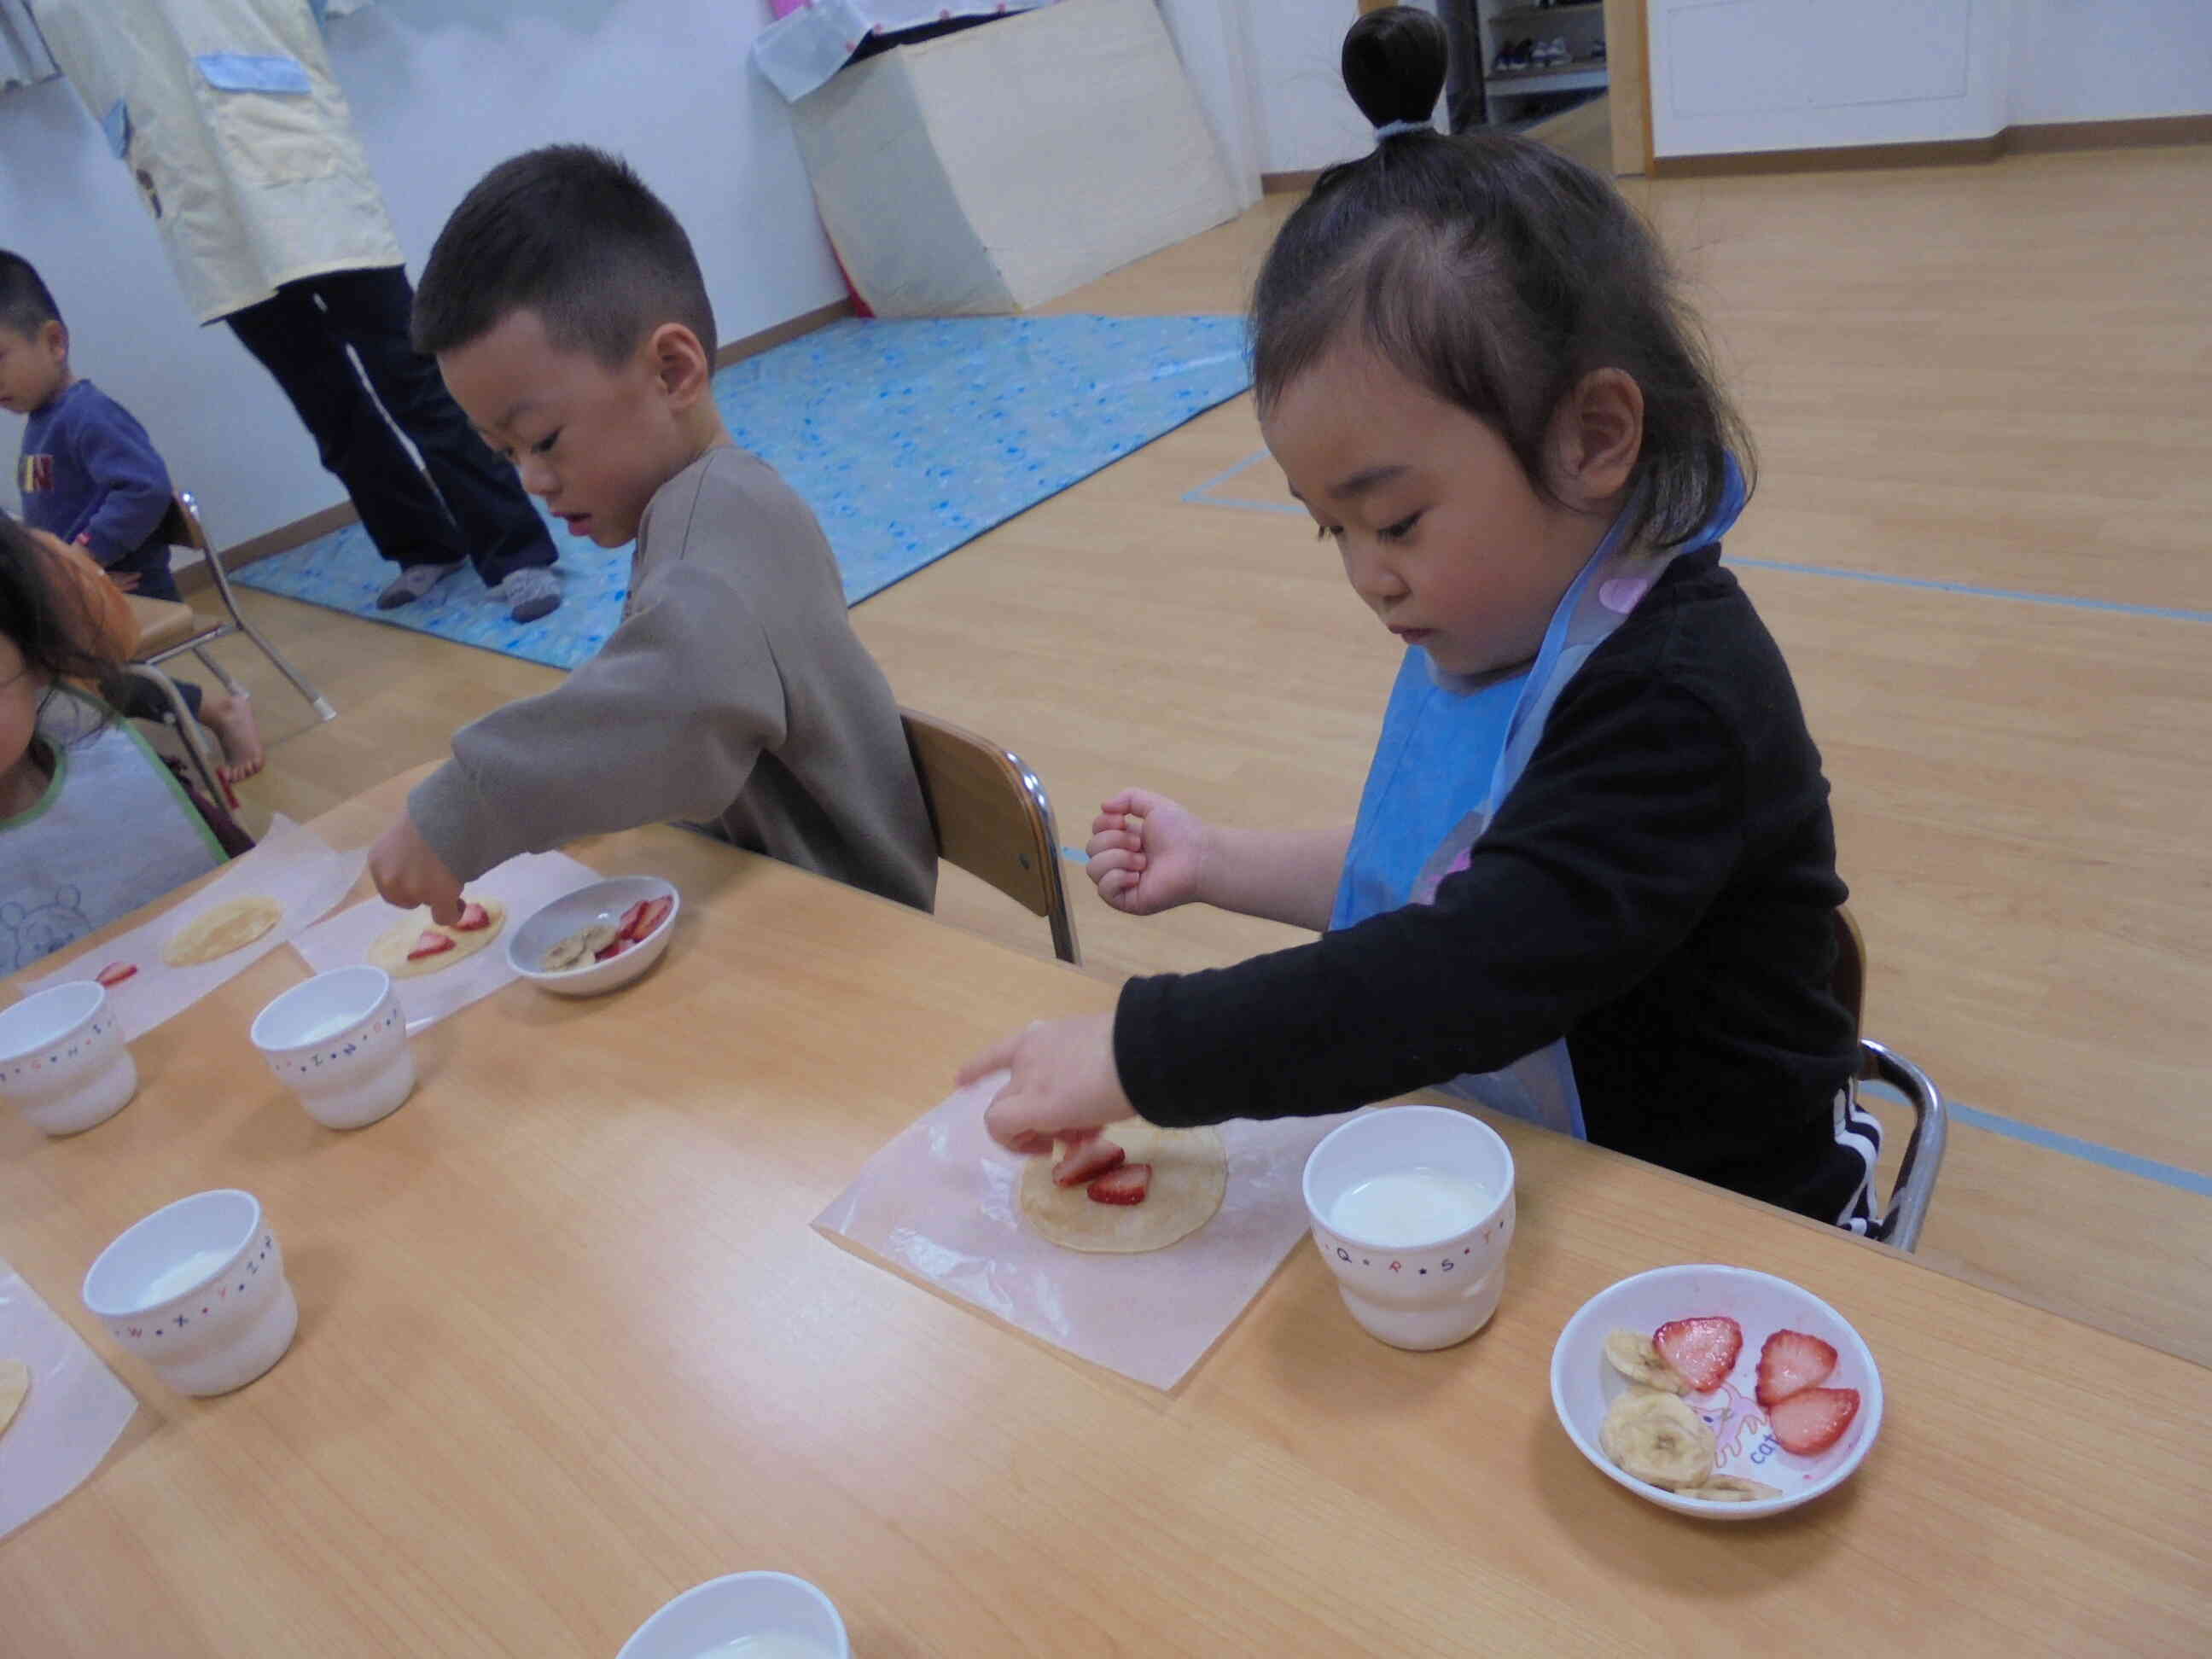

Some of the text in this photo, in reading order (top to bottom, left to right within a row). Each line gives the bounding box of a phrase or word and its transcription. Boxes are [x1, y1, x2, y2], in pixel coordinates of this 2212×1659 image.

[1336, 1247, 1353, 1264] Q
[1388, 1260, 1402, 1273] R
[1441, 1258, 1454, 1272] S
[1749, 1434, 1782, 1464] cat
